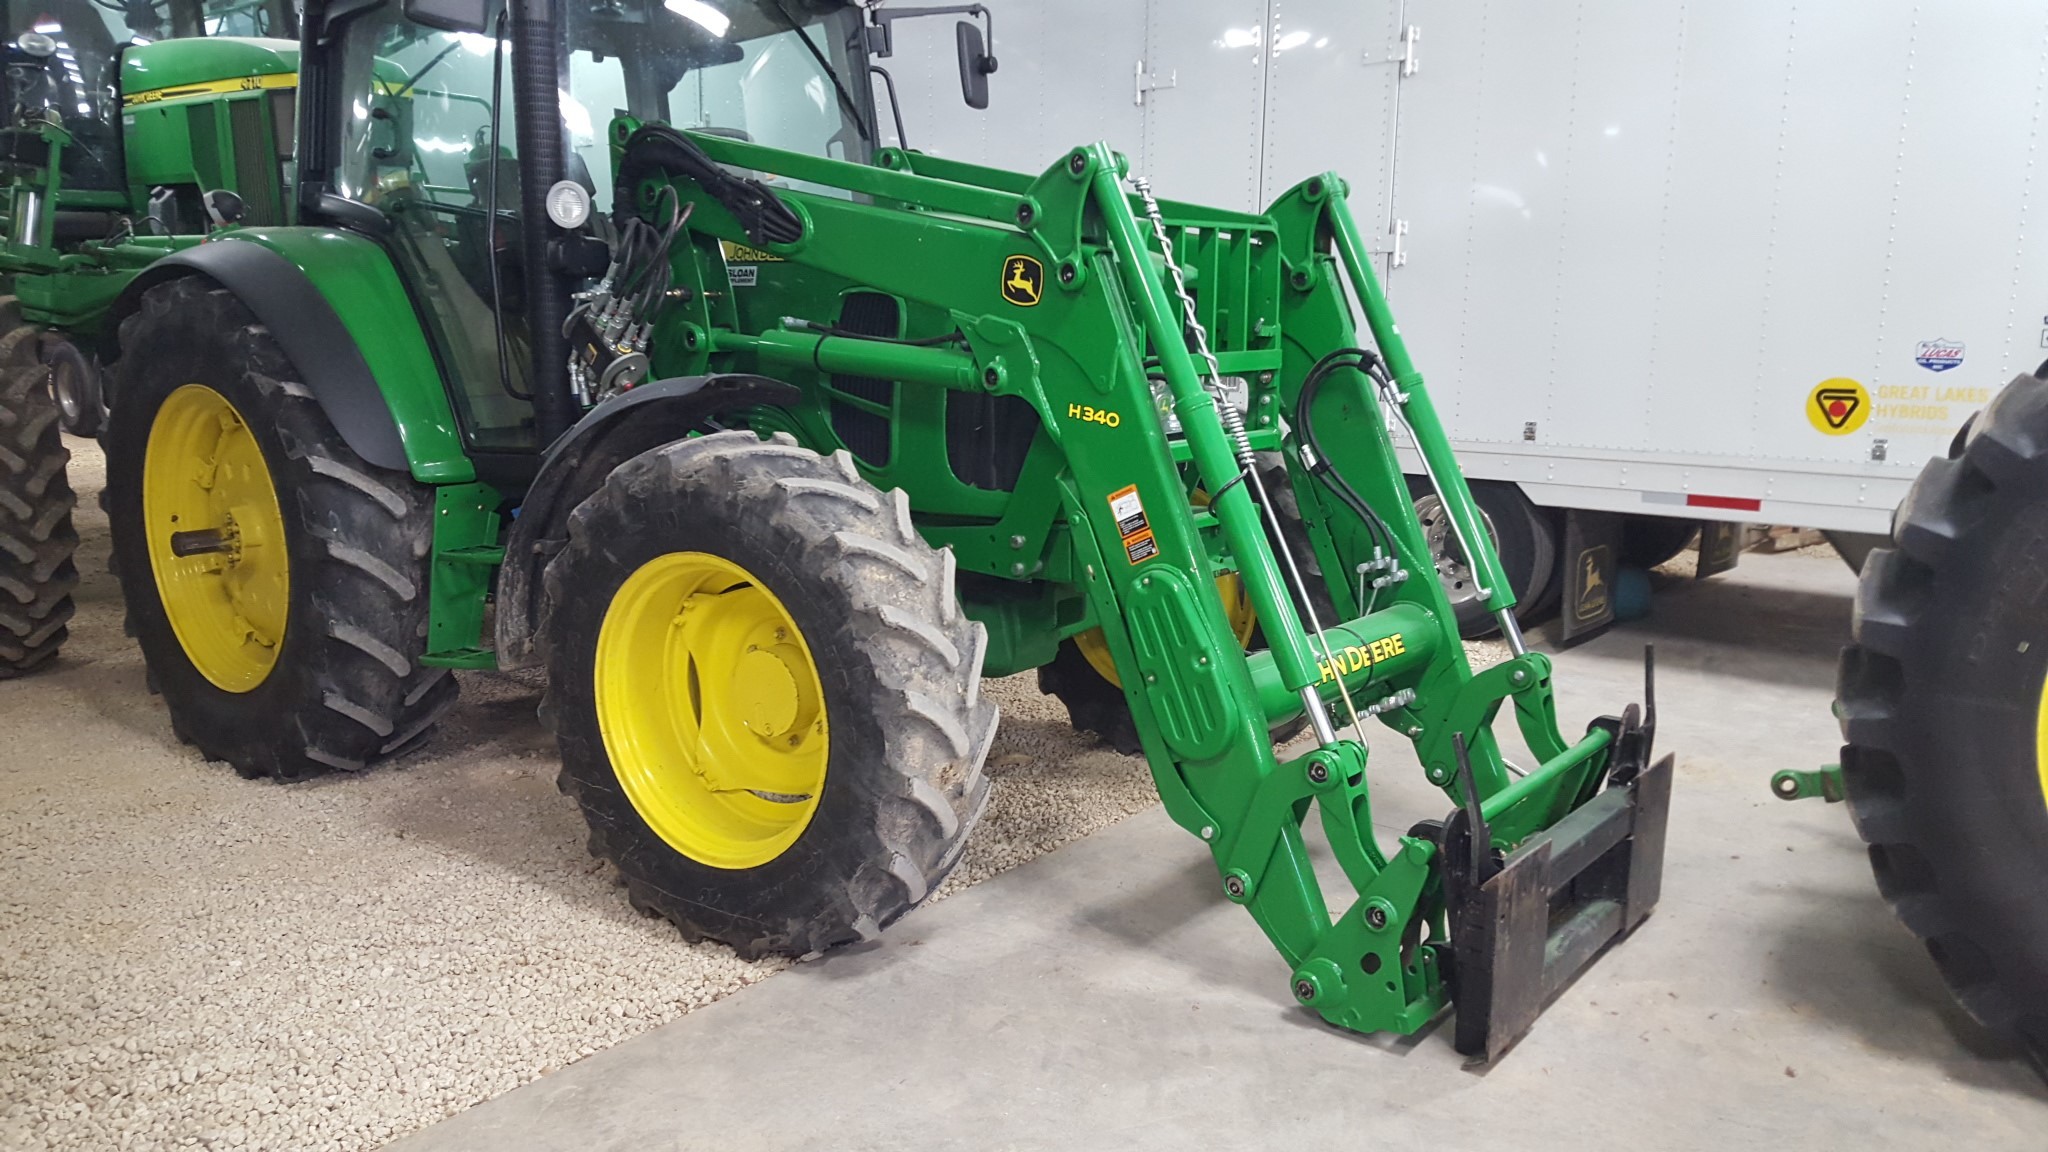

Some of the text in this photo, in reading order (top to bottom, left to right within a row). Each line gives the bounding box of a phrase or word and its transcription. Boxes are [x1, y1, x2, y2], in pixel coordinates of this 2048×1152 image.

[730, 245, 758, 259] JOHN
[728, 269, 755, 277] SLOAN
[1921, 349, 1962, 357] LUCAS
[1878, 385, 1989, 403] GREAT LAKES
[1877, 403, 1948, 420] HYBRIDS
[1315, 633, 1405, 687] HN DEERE
